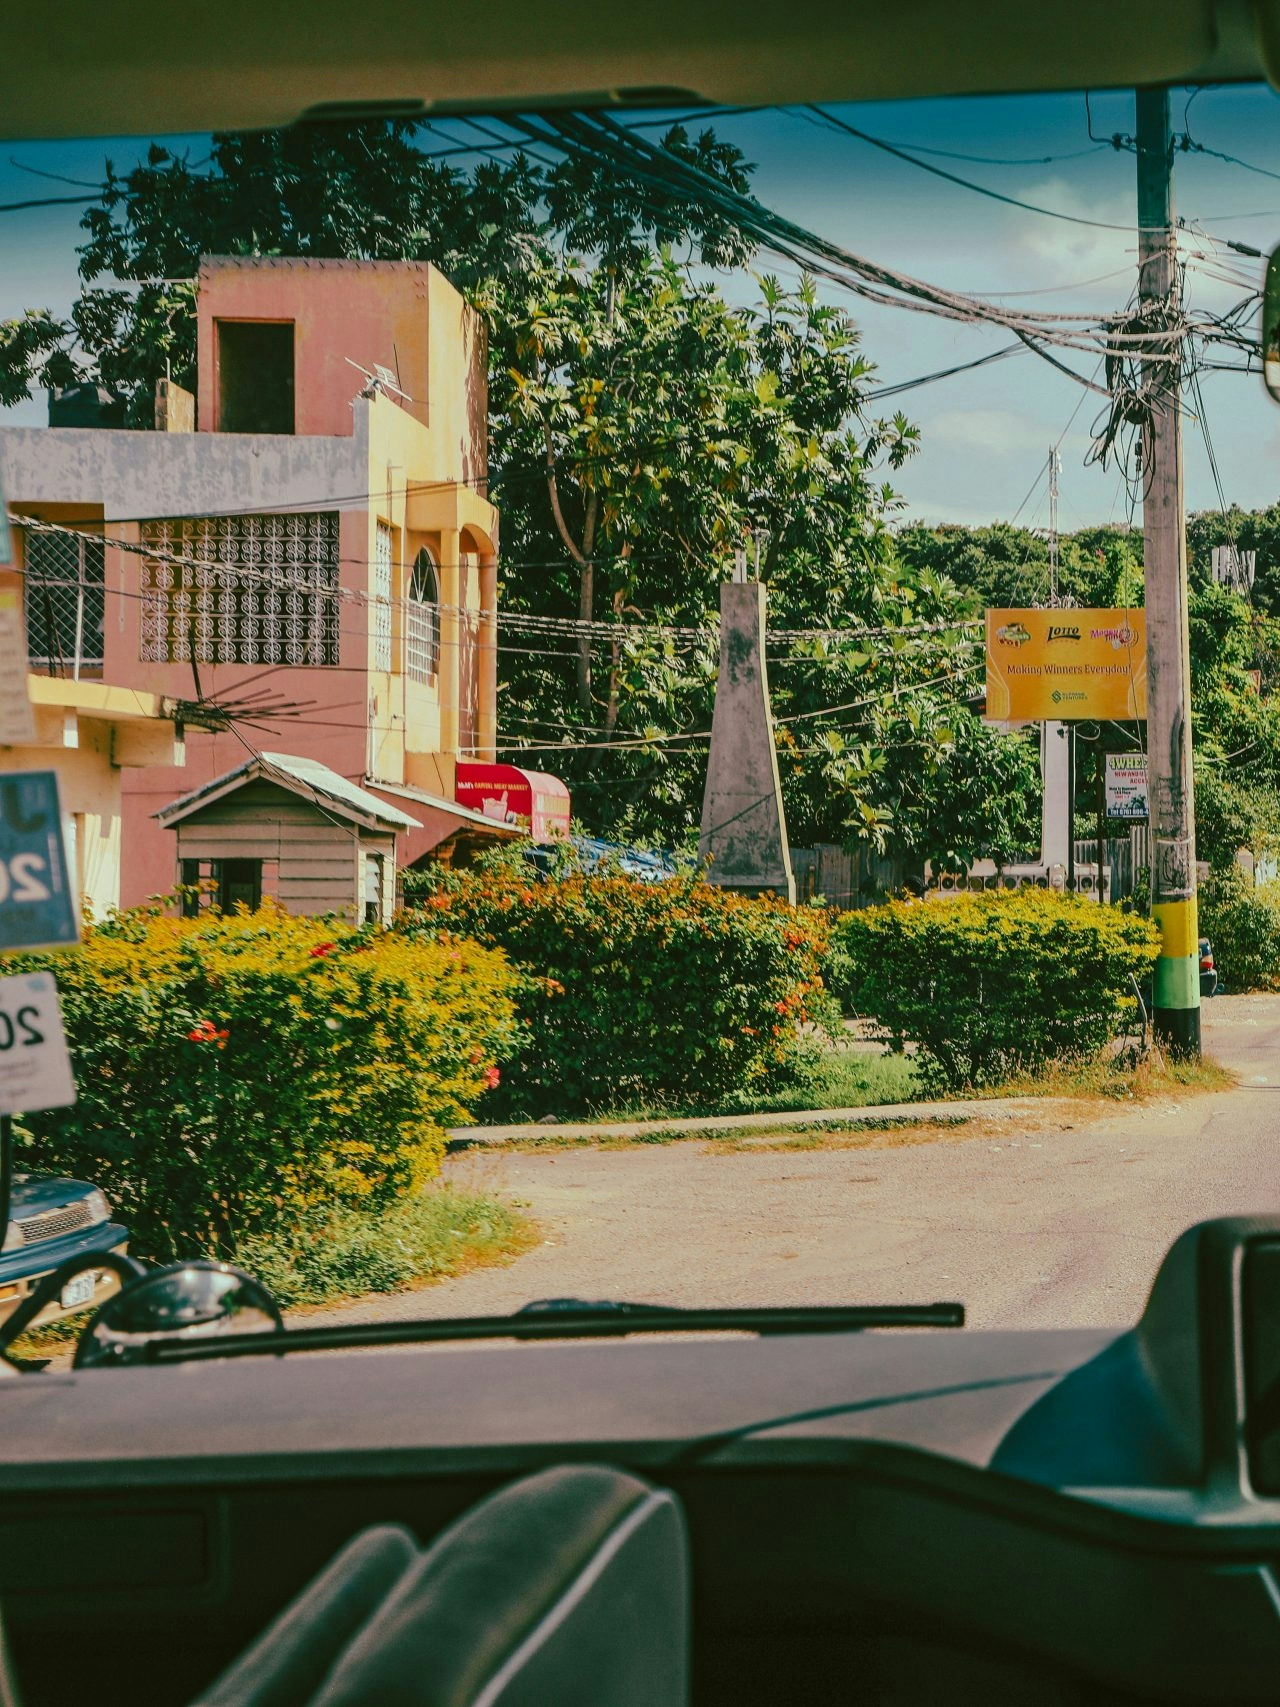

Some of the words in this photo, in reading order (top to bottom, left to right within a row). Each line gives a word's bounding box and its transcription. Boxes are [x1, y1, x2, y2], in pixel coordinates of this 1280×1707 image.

[1007, 665, 1042, 675] Making
[1044, 664, 1083, 674] Winners
[1084, 664, 1132, 675] Everyday!
